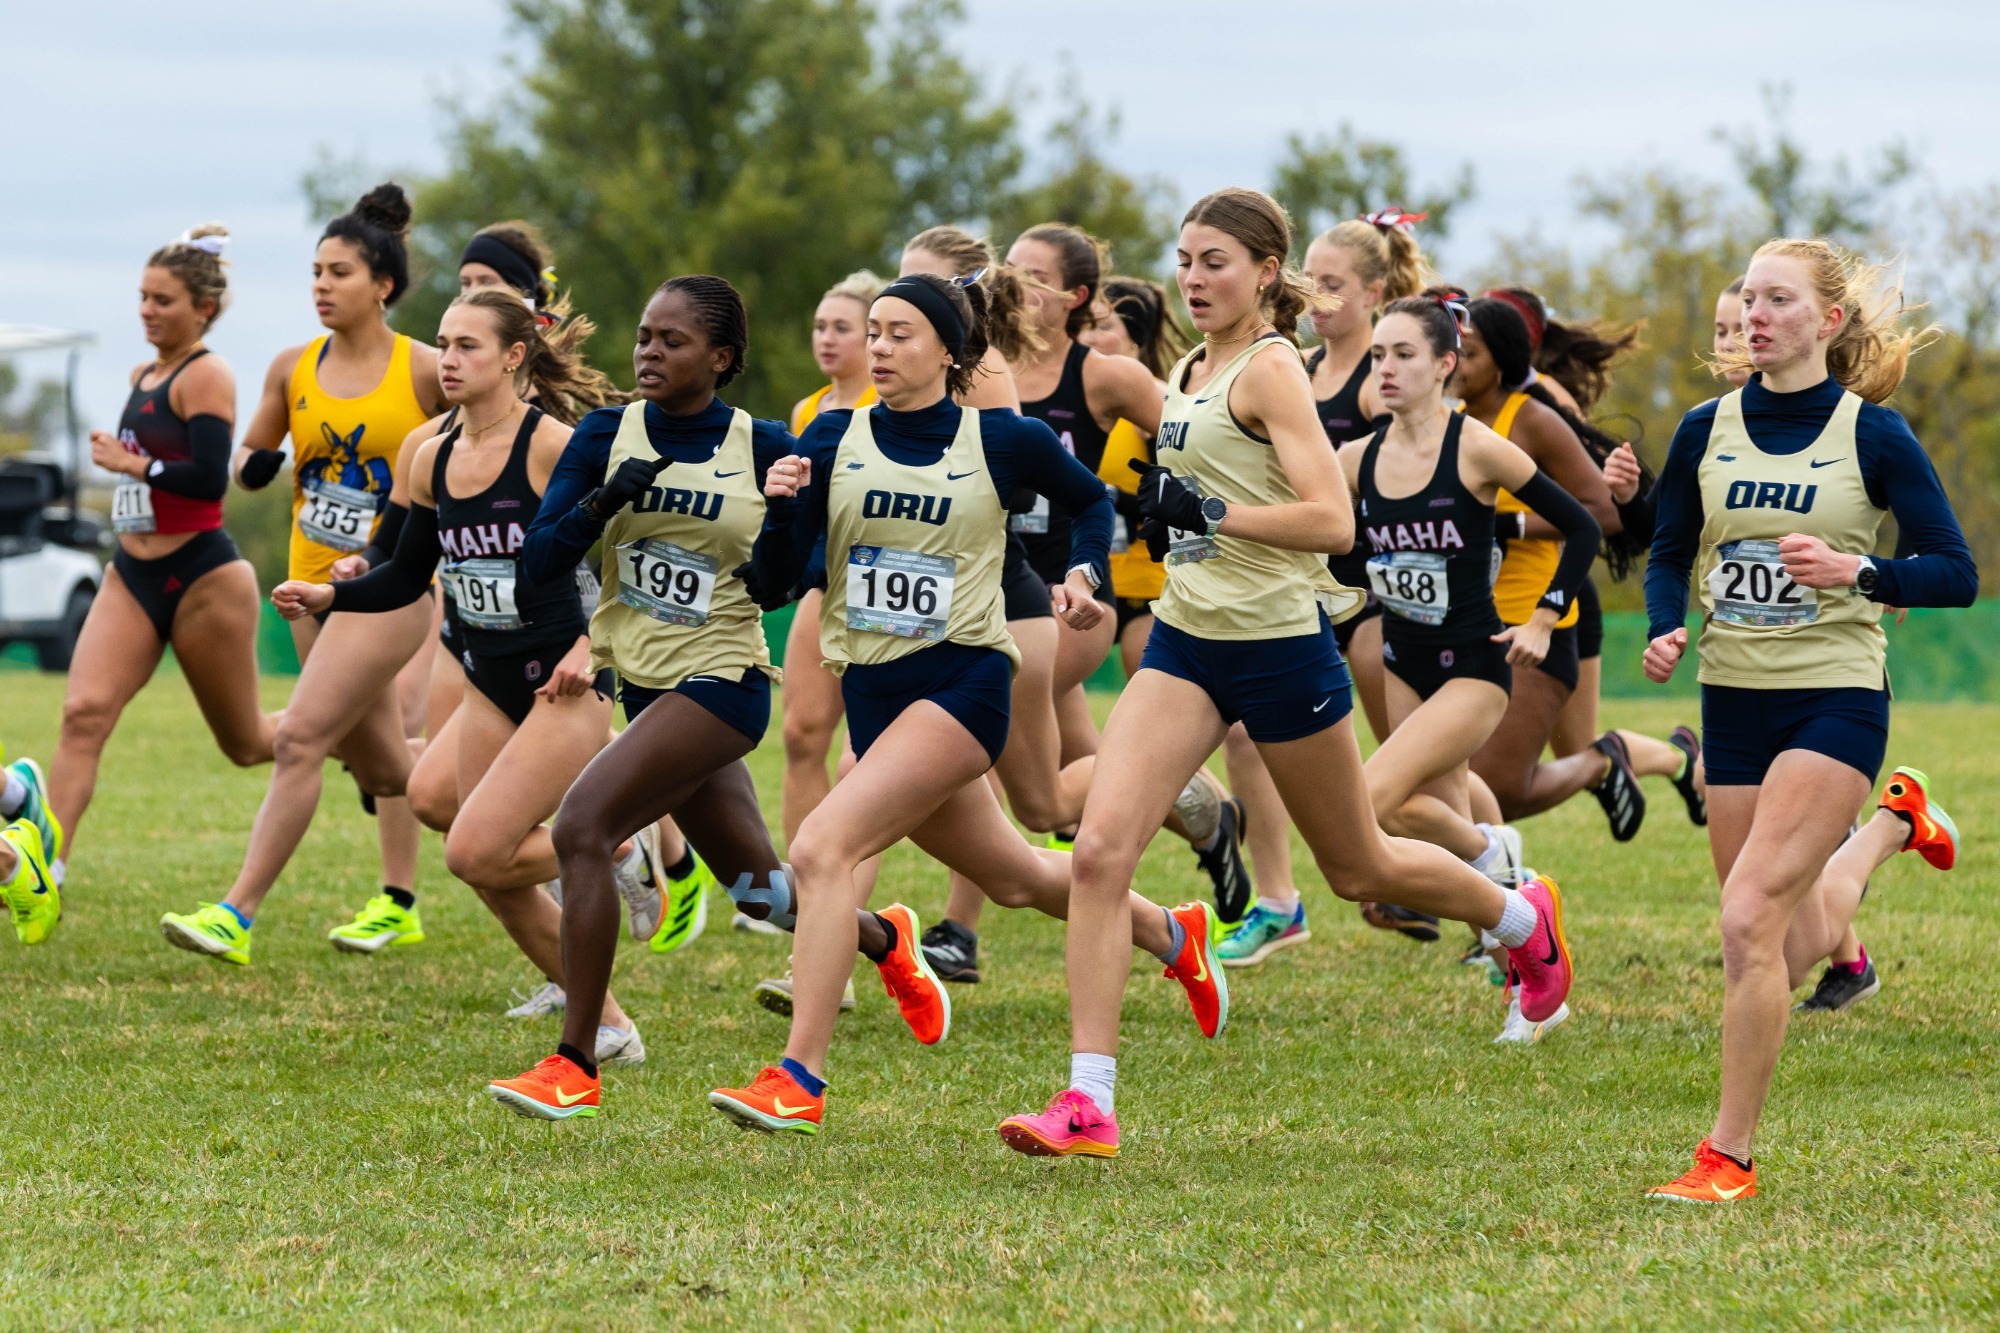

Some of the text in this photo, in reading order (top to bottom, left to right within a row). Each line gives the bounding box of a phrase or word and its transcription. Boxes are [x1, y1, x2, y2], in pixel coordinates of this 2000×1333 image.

[1157, 422, 1190, 451] ORU
[631, 486, 724, 521] ORU
[862, 489, 952, 526] ORU
[1725, 480, 1818, 514] ORU
[458, 575, 502, 613] 191
[629, 553, 699, 606] 199
[862, 569, 938, 616] 196
[1377, 568, 1436, 604] 188
[1722, 562, 1802, 604] 202
